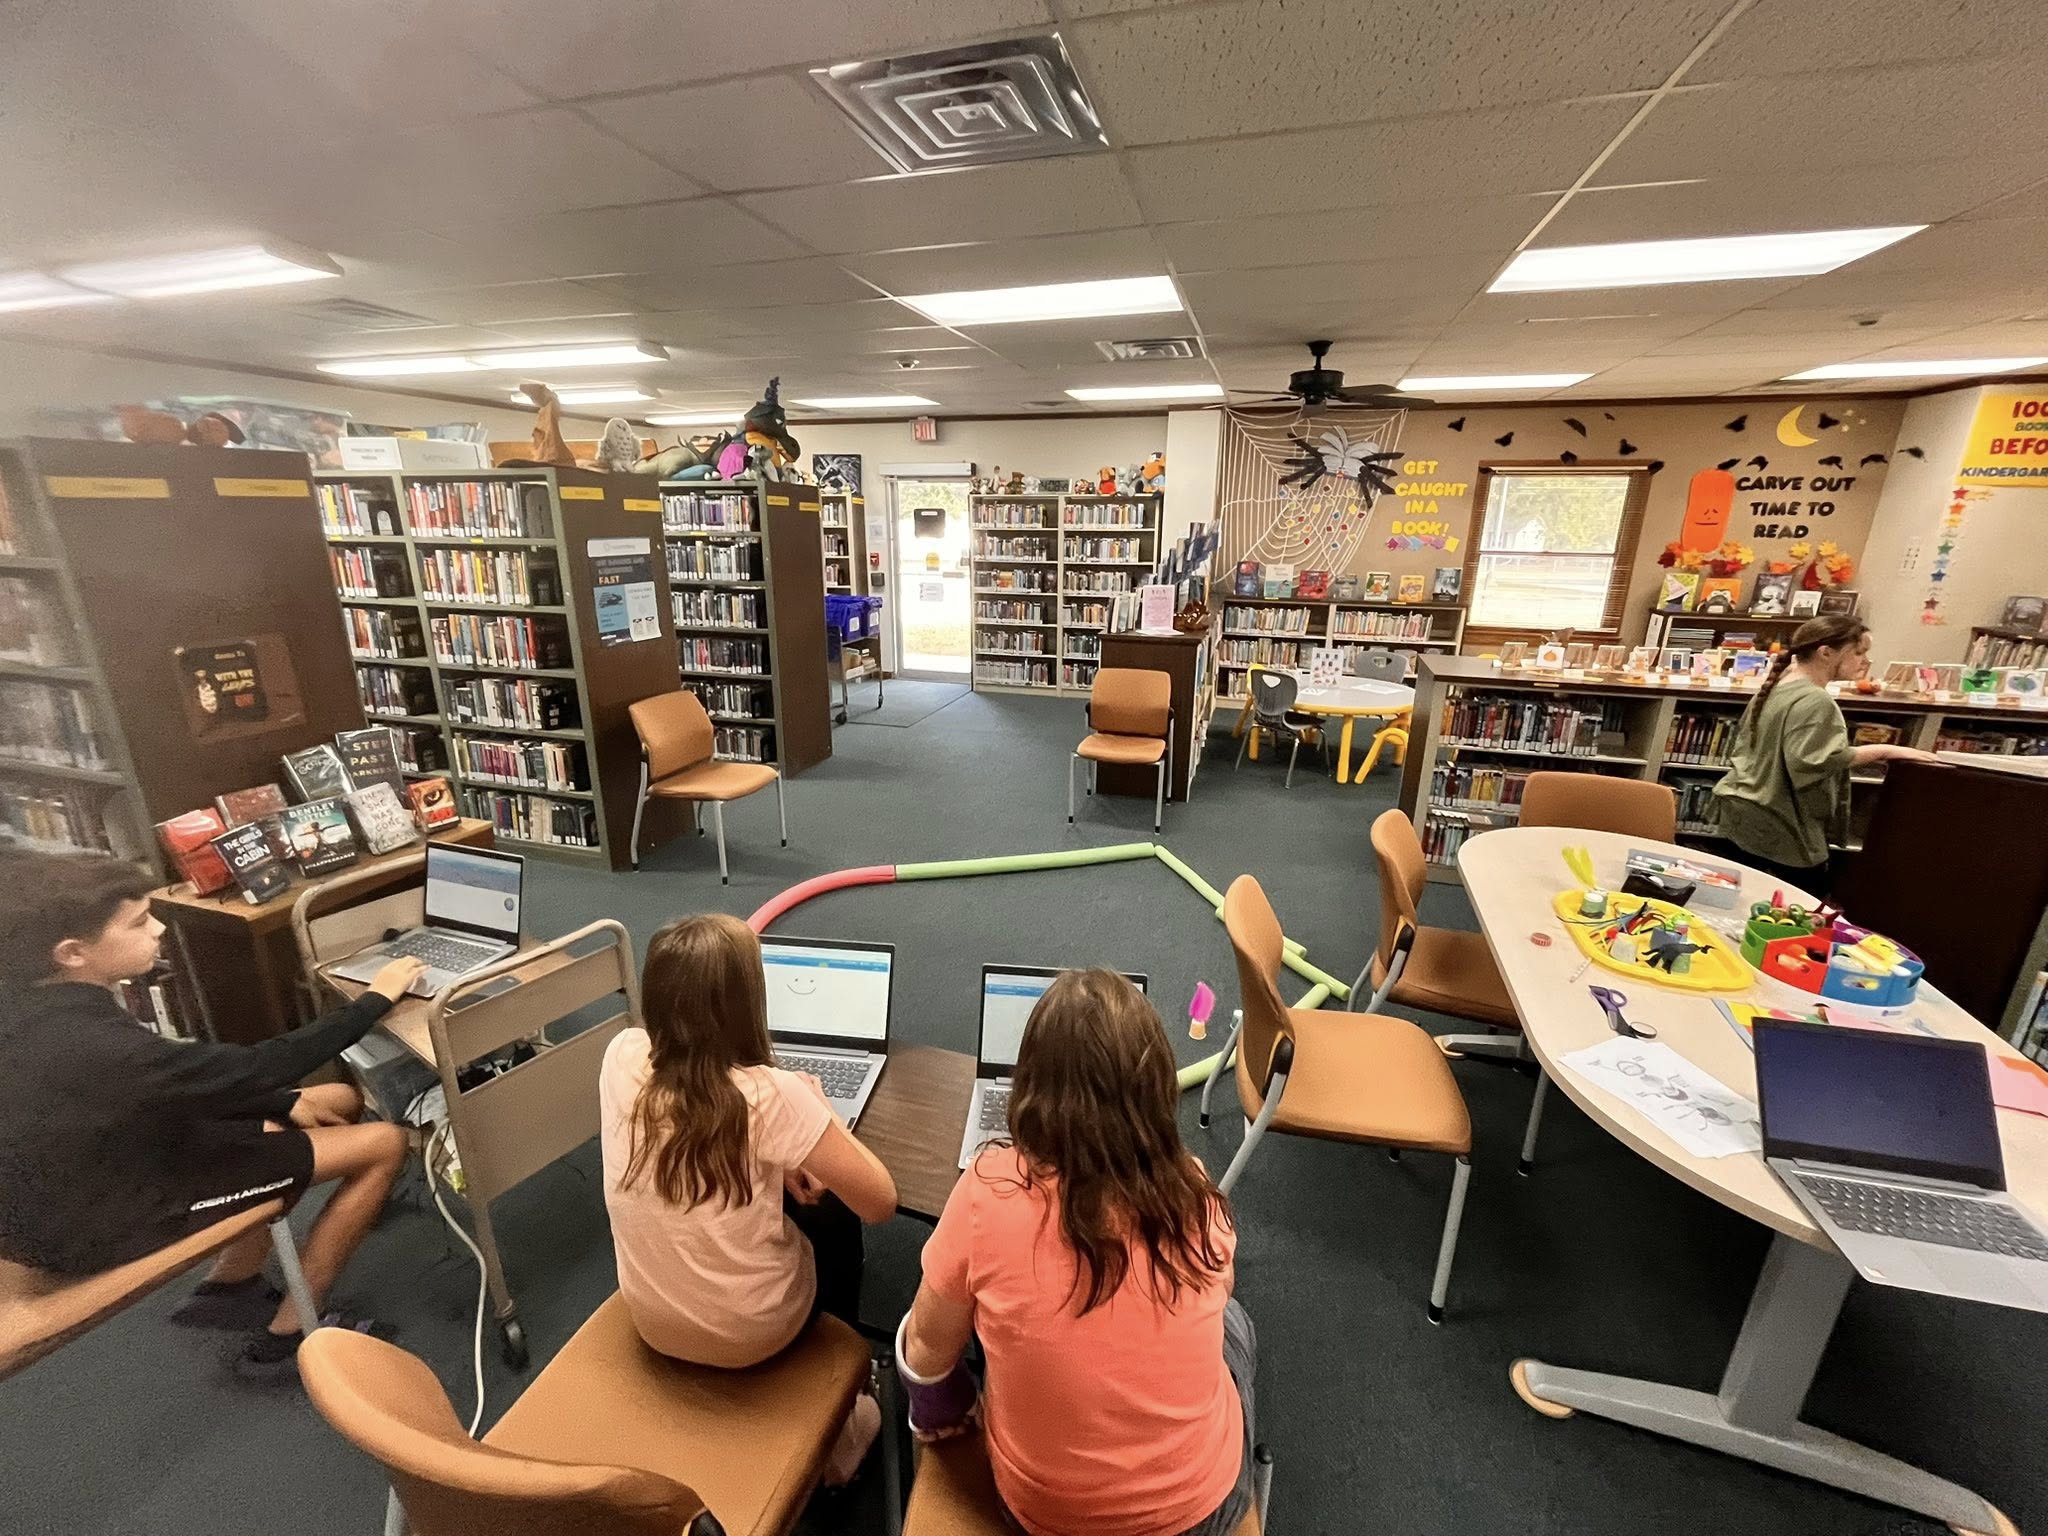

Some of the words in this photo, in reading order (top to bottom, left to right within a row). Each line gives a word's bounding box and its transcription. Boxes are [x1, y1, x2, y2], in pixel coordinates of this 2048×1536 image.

[1989, 438, 2048, 455] BEFO
[1403, 461, 1438, 475] GET
[1395, 482, 1468, 496] CAUGHT
[1736, 476, 1804, 491] CARVE
[1810, 477, 1856, 491] OUT
[1405, 500, 1424, 514] IN
[1425, 500, 1439, 514] A
[1750, 502, 1801, 516] TIME
[1808, 502, 1835, 516] TO
[1392, 521, 1449, 537] BOOK!
[1754, 524, 1809, 539] READ
[599, 575, 620, 585] FAST
[353, 740, 389, 752] STEP
[350, 753, 386, 766] PAST
[289, 801, 335, 818] BENTLEY
[371, 809, 393, 821] WAS
[234, 844, 271, 867] CABIN
